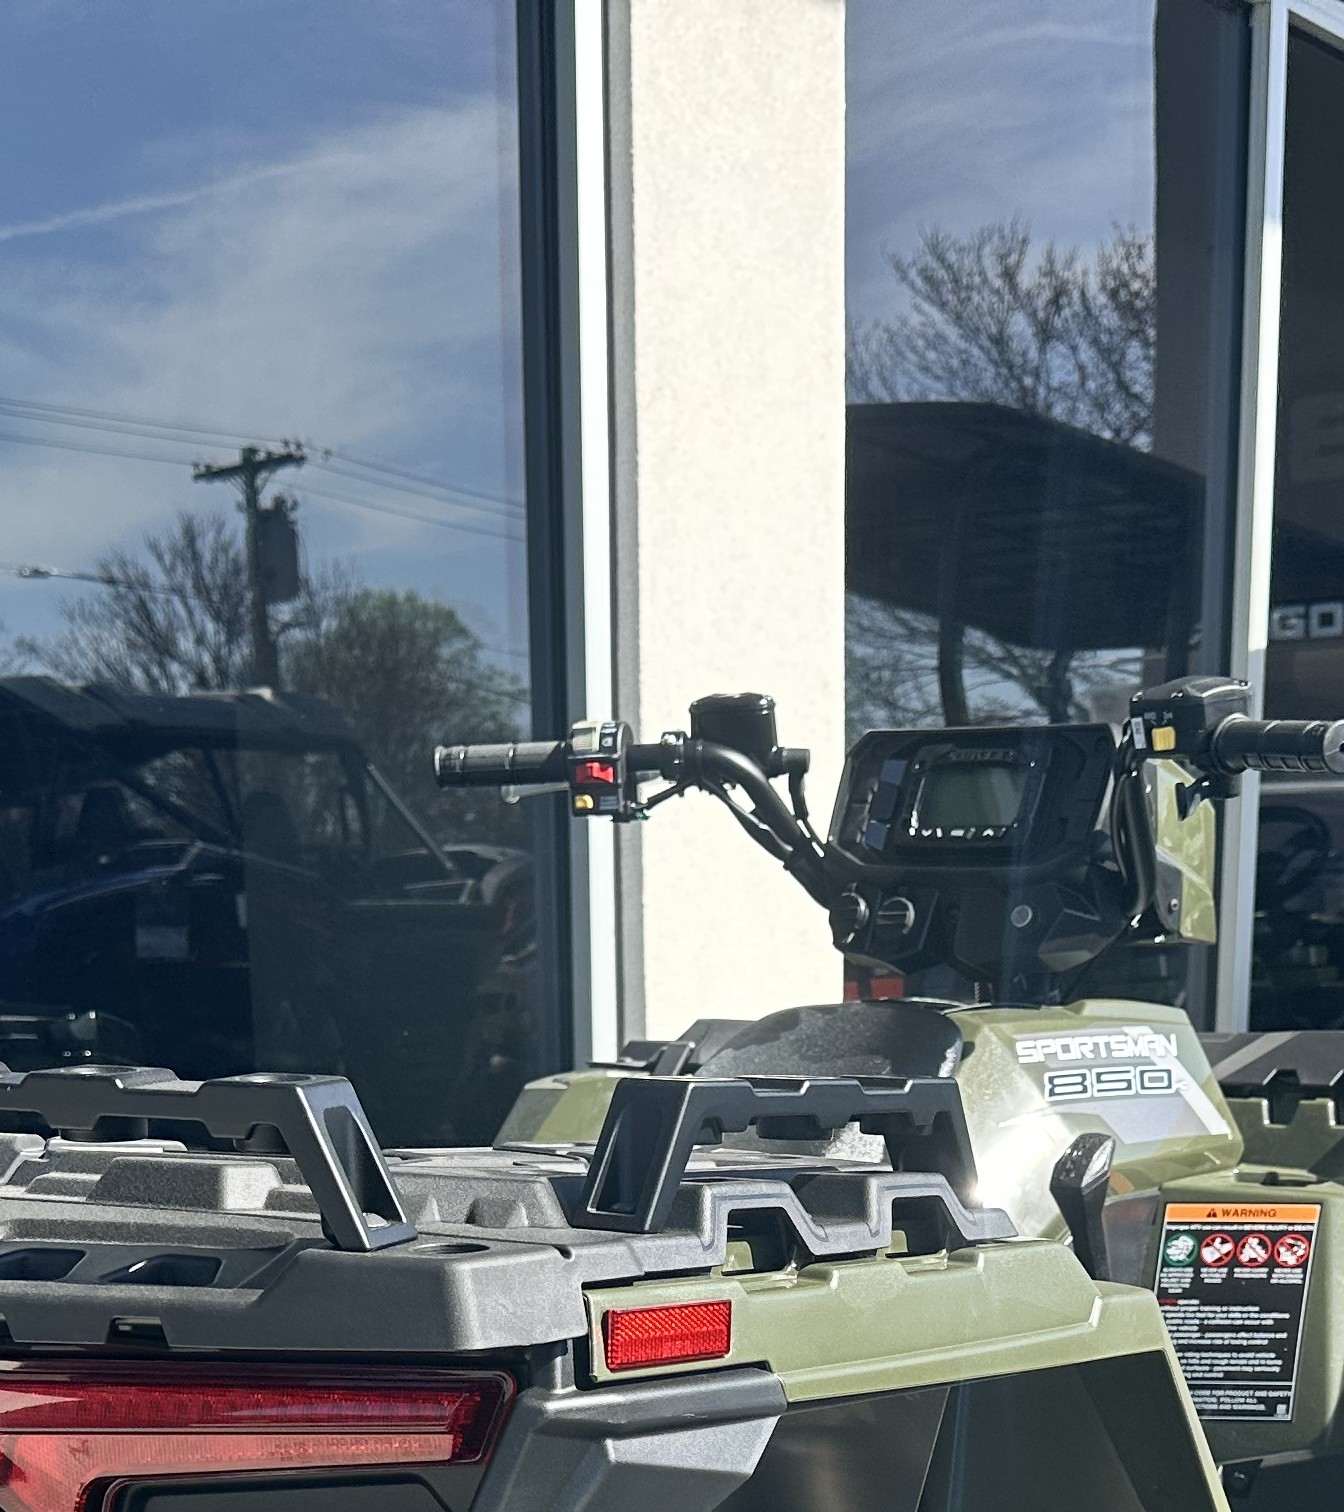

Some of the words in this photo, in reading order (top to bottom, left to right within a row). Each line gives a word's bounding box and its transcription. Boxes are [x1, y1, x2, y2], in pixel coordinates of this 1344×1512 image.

[1015, 1033, 1178, 1064] SPORTSMAN
[1043, 1065, 1176, 1102] 850
[1221, 1208, 1278, 1219] WARNING
